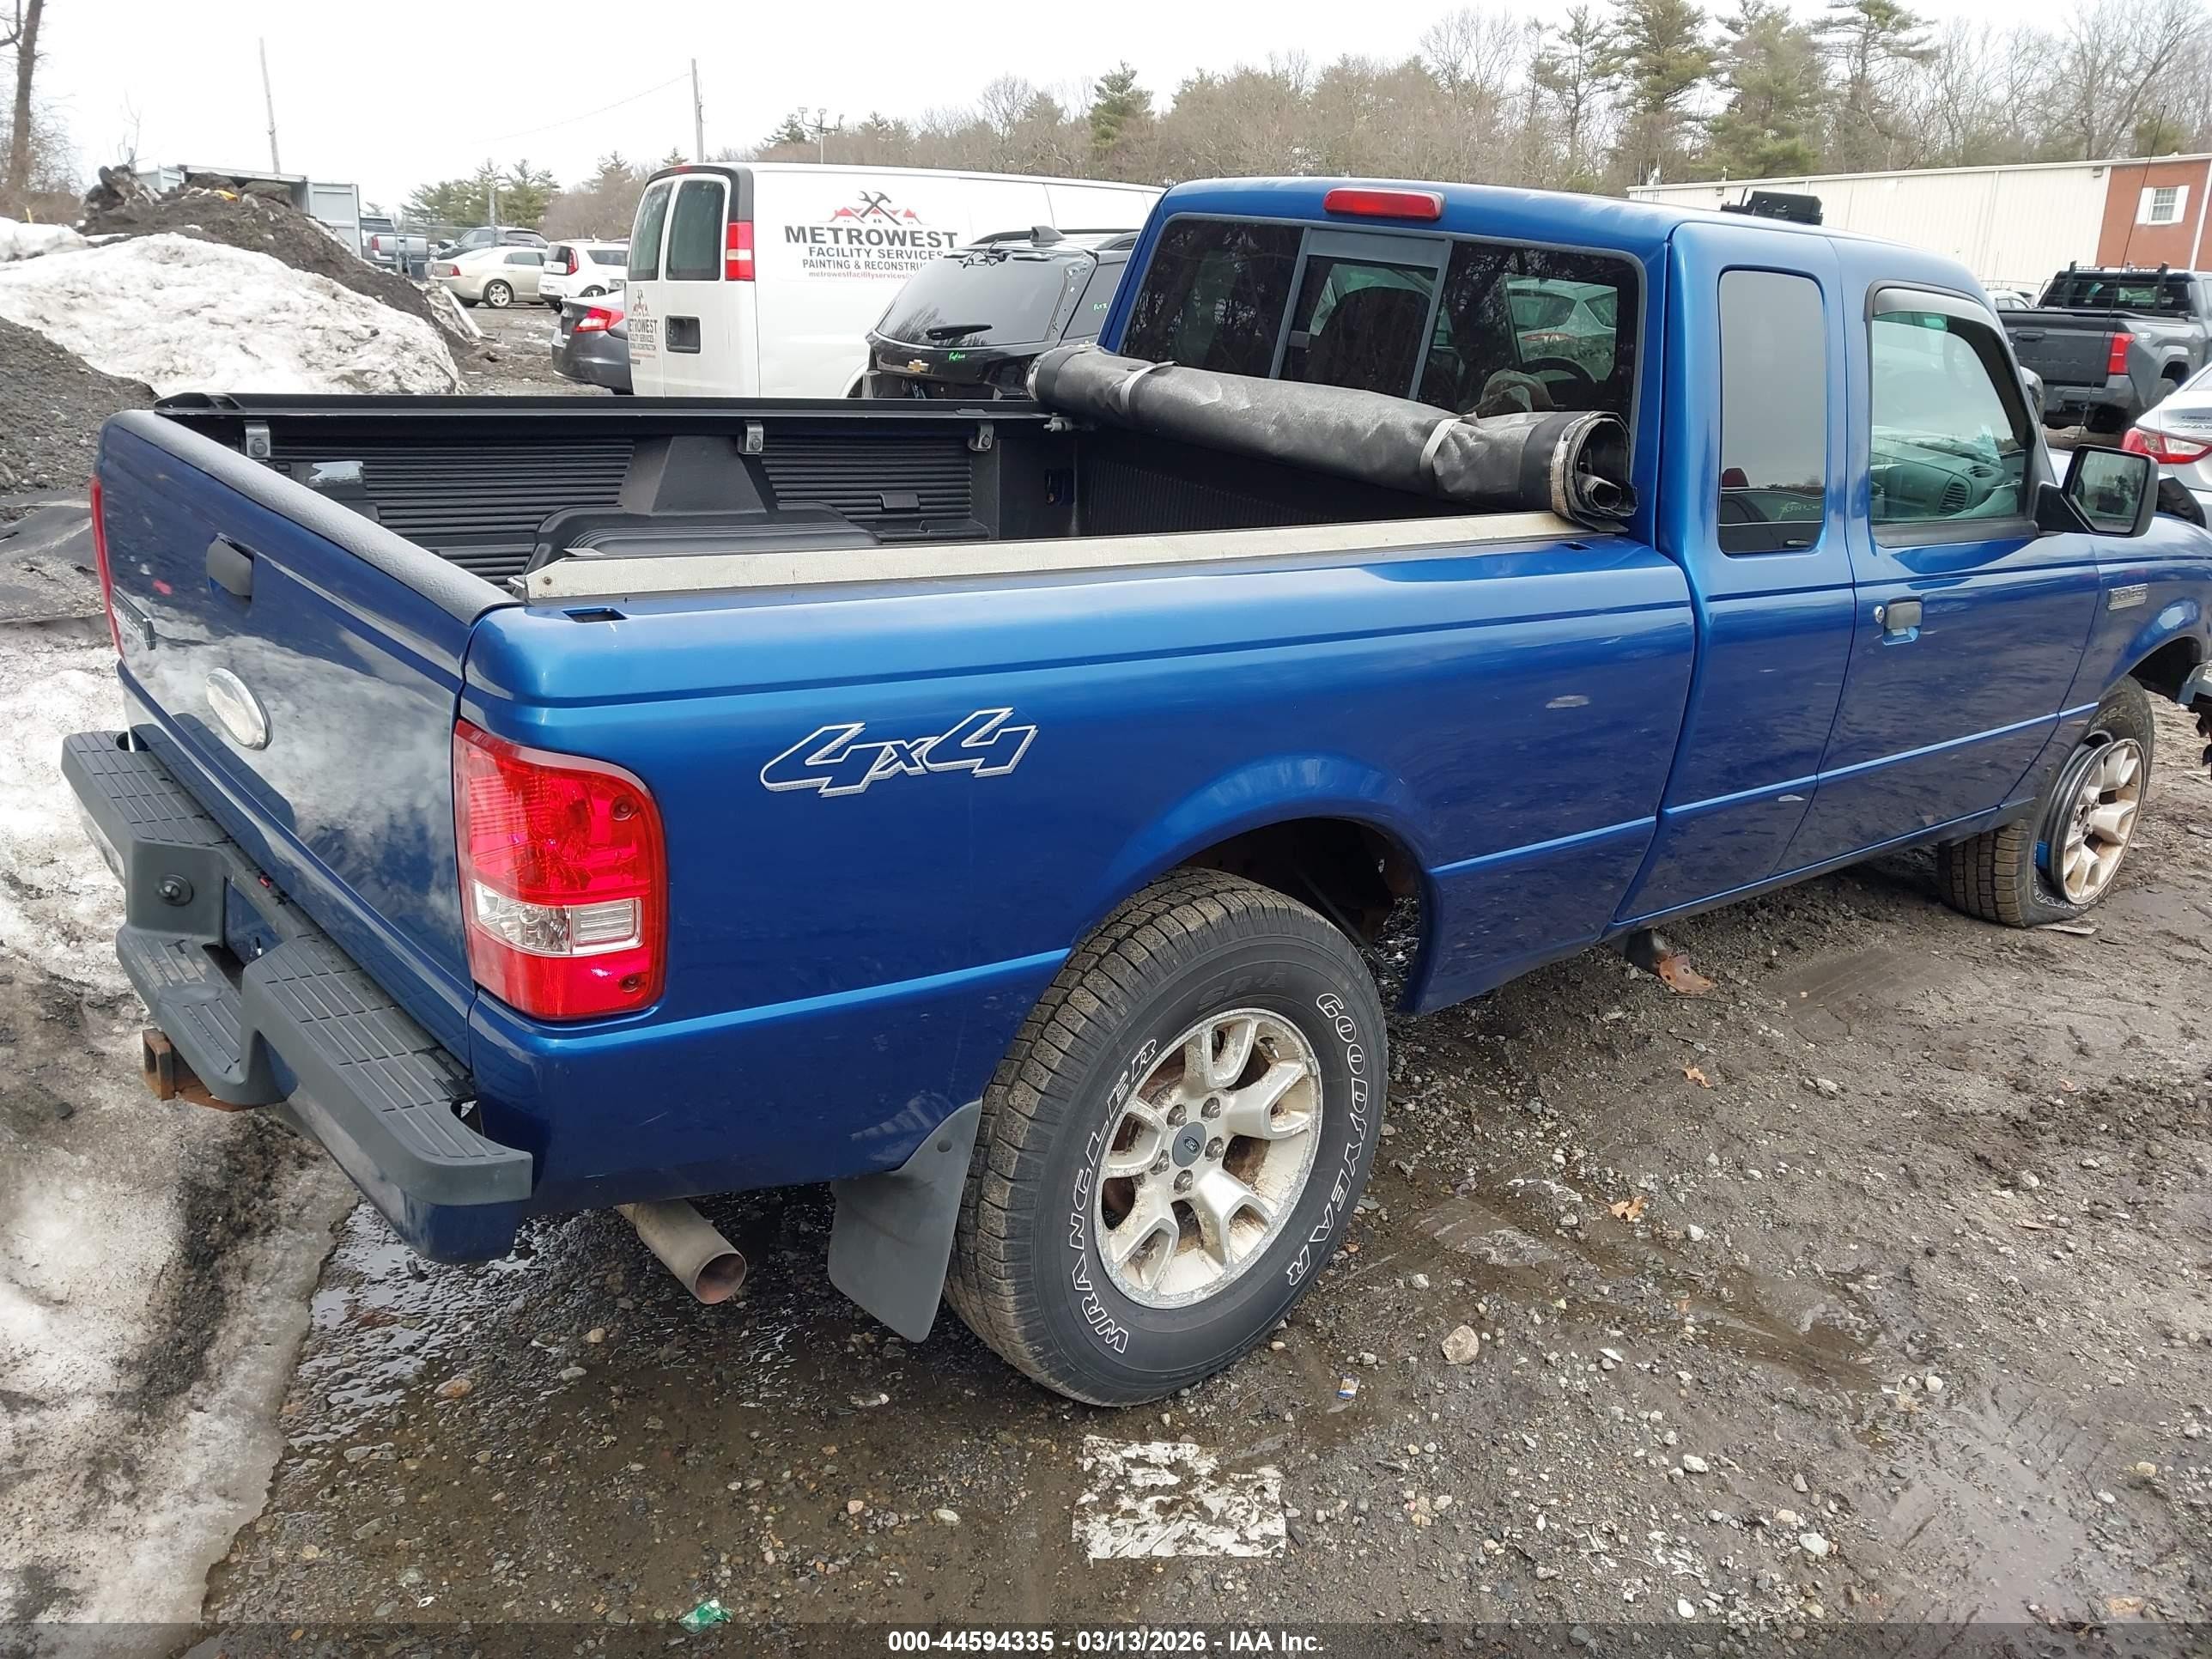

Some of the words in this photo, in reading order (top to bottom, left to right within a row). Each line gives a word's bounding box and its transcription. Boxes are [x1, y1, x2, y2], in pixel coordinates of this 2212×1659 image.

[785, 225, 957, 248] METROWEST
[802, 258, 850, 270] PAINTING
[854, 260, 861, 270] &
[809, 246, 872, 259] FACILITY
[1286, 993, 1368, 1285] GOODYEAR
[1070, 1039, 1158, 1353] WRANGLER
